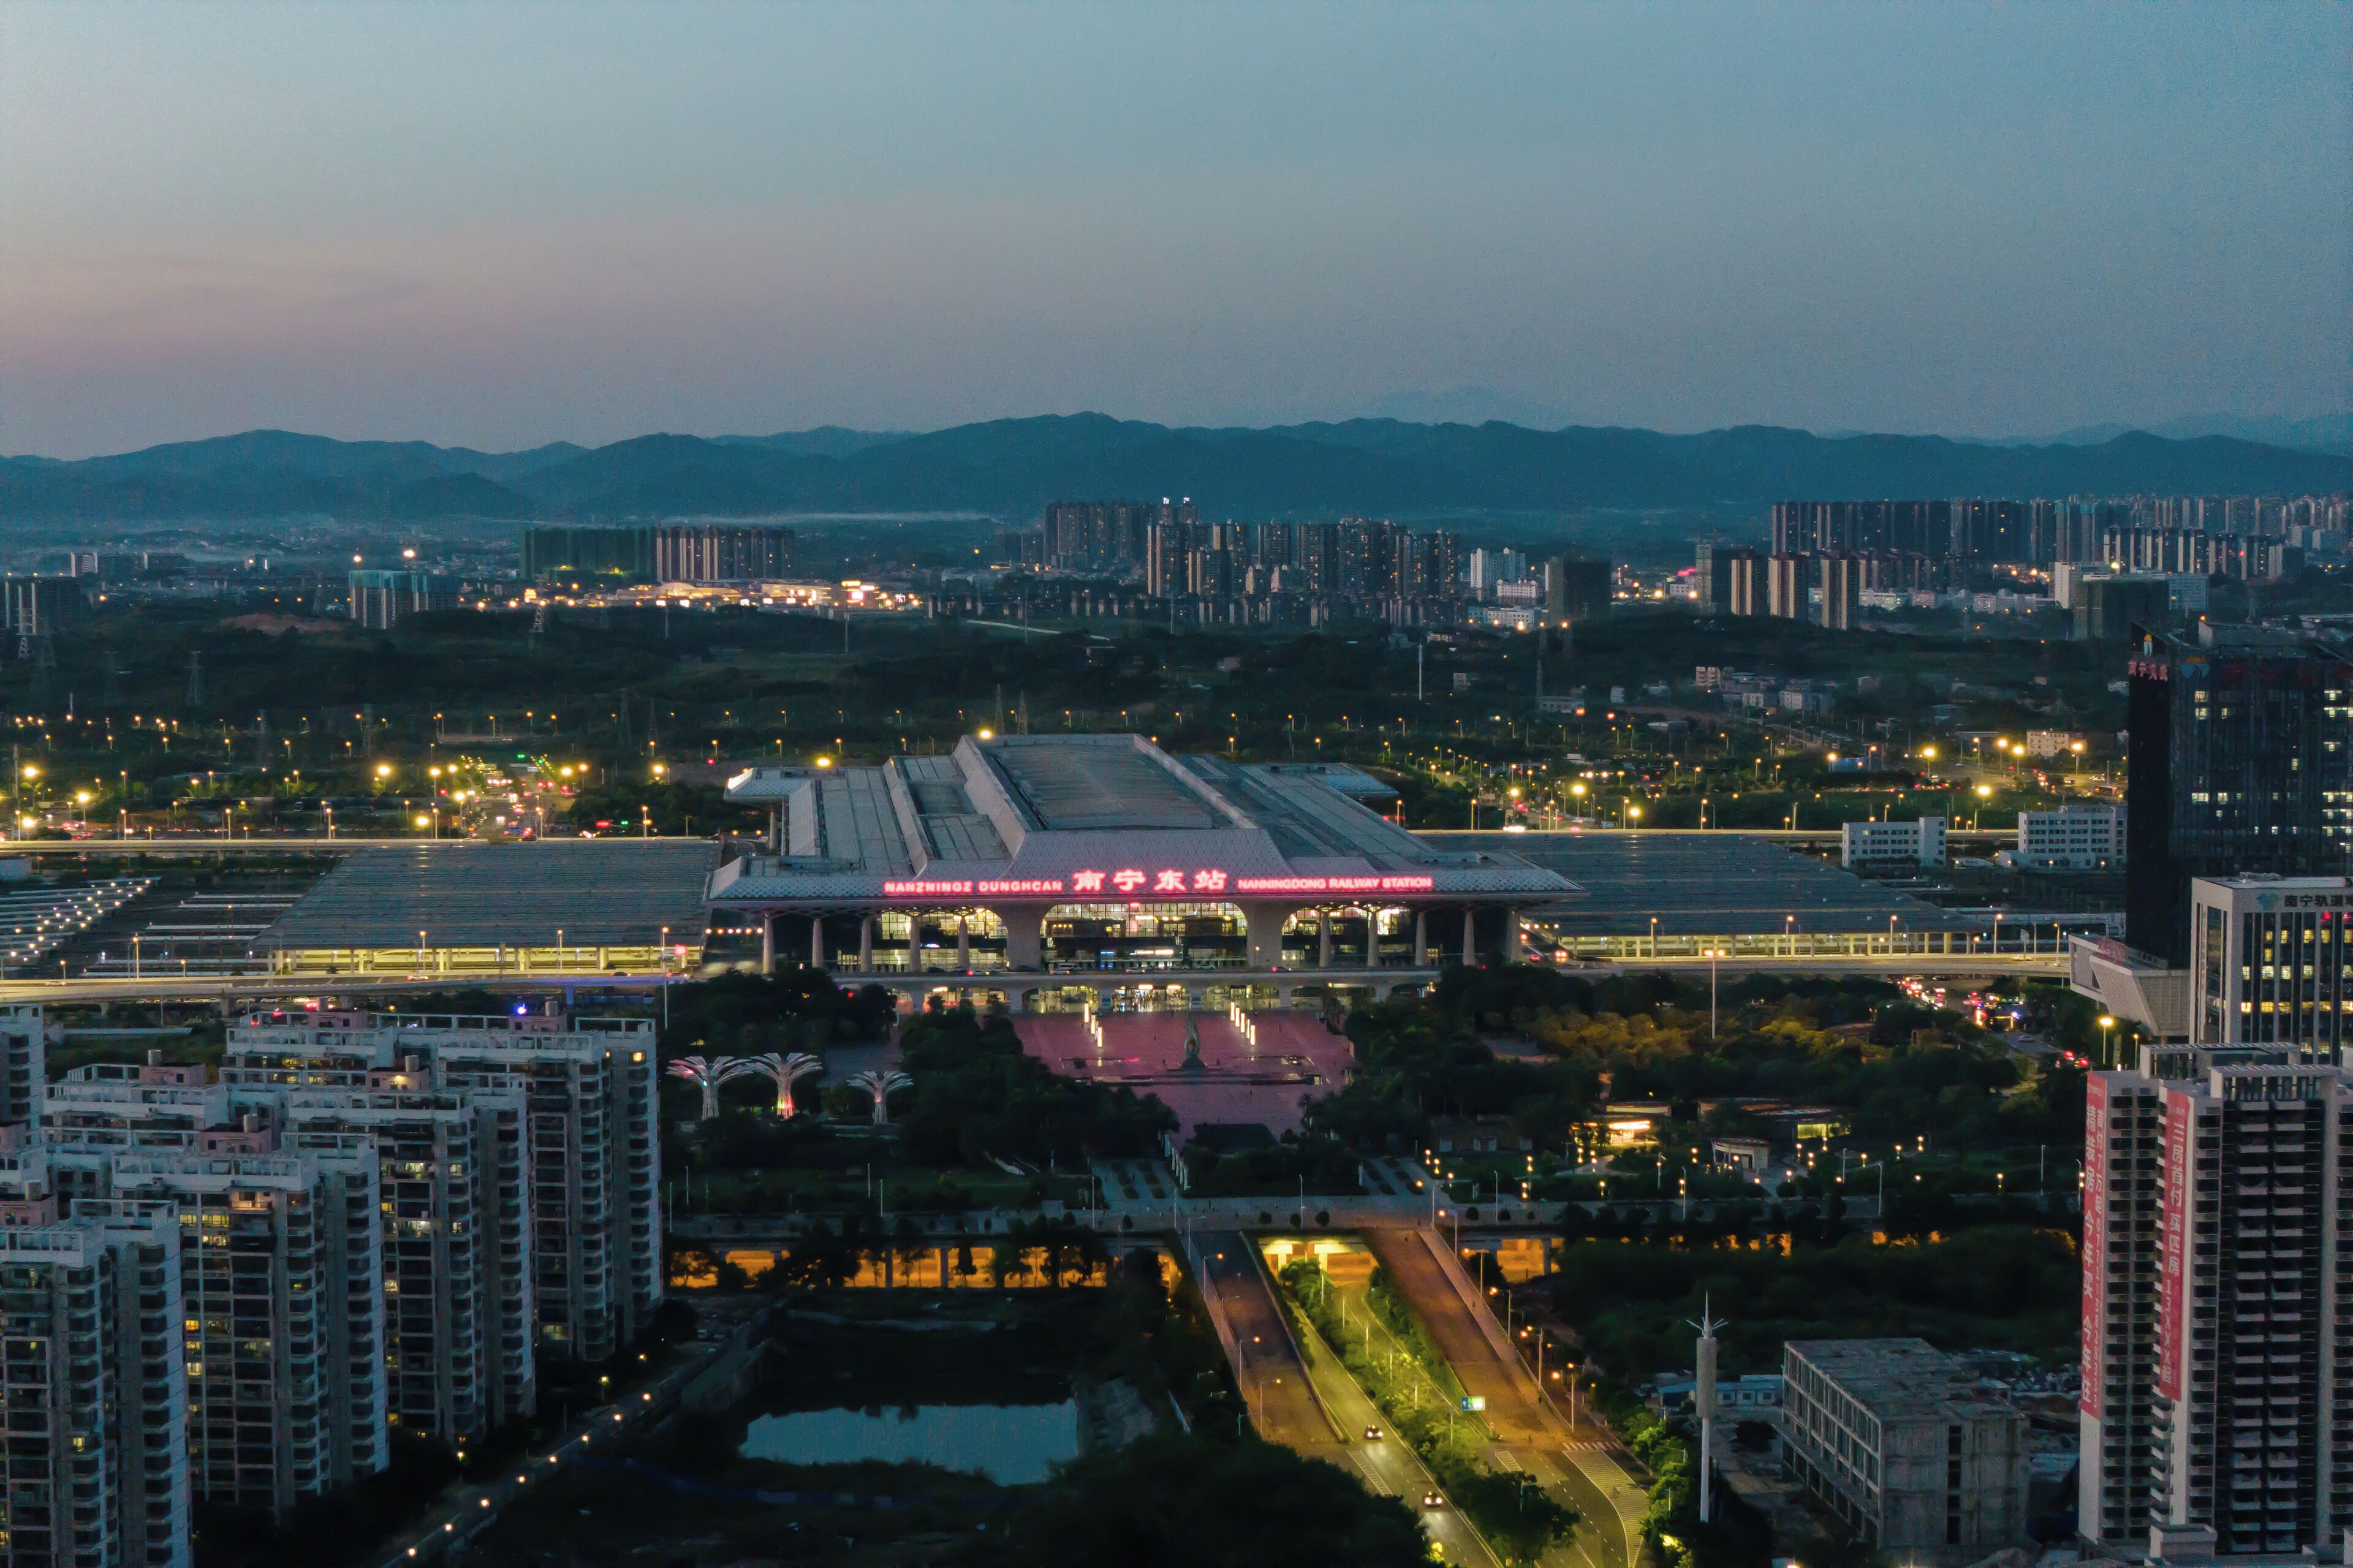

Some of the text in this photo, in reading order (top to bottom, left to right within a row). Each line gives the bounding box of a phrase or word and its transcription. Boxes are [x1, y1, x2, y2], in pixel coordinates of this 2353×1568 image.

[979, 881, 1062, 892] DUNGHCAN
[1072, 869, 1227, 892] 南宁东站
[1238, 876, 1432, 889] NANNINGDONG RAILWAY STATION
